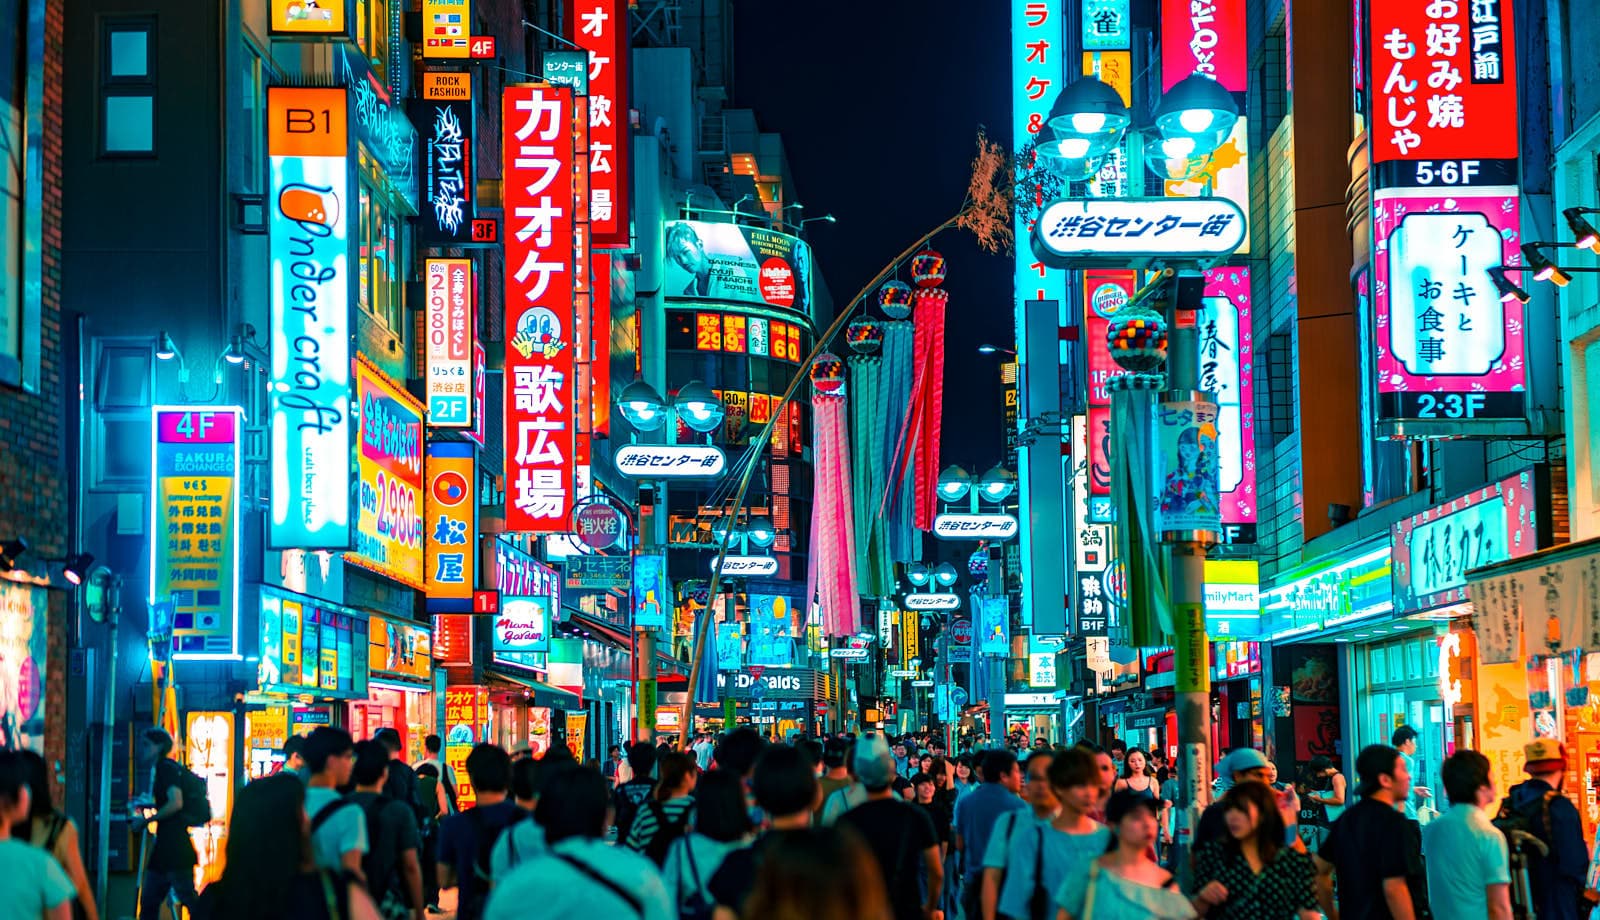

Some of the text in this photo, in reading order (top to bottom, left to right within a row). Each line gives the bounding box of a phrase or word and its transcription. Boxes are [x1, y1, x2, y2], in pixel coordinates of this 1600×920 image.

[472, 41, 492, 54] 4F
[1425, 0, 1464, 128] お好み焼
[436, 76, 460, 86] ROCK
[430, 87, 466, 96] FASHION
[286, 109, 331, 134] B1
[476, 222, 493, 239] 3F
[1050, 214, 1235, 237] 渋谷センター街
[1452, 224, 1476, 331] ケーキと
[513, 89, 566, 520] カラオケ 歌広場
[1098, 298, 1124, 311] KING
[1418, 278, 1446, 363] お食事
[278, 336, 342, 435] craft
[432, 382, 465, 393] 渋谷店
[436, 401, 463, 418] 2F
[176, 411, 215, 439] 4F
[175, 453, 235, 462] SAKURA
[620, 454, 719, 467] 渋谷センター街
[579, 517, 617, 535] 消火栓
[938, 520, 1014, 531] 渋谷センター街
[434, 515, 468, 583] 松屋
[714, 561, 775, 571] 谷センター街
[495, 618, 535, 629] Miami
[1082, 621, 1104, 630] B1F
